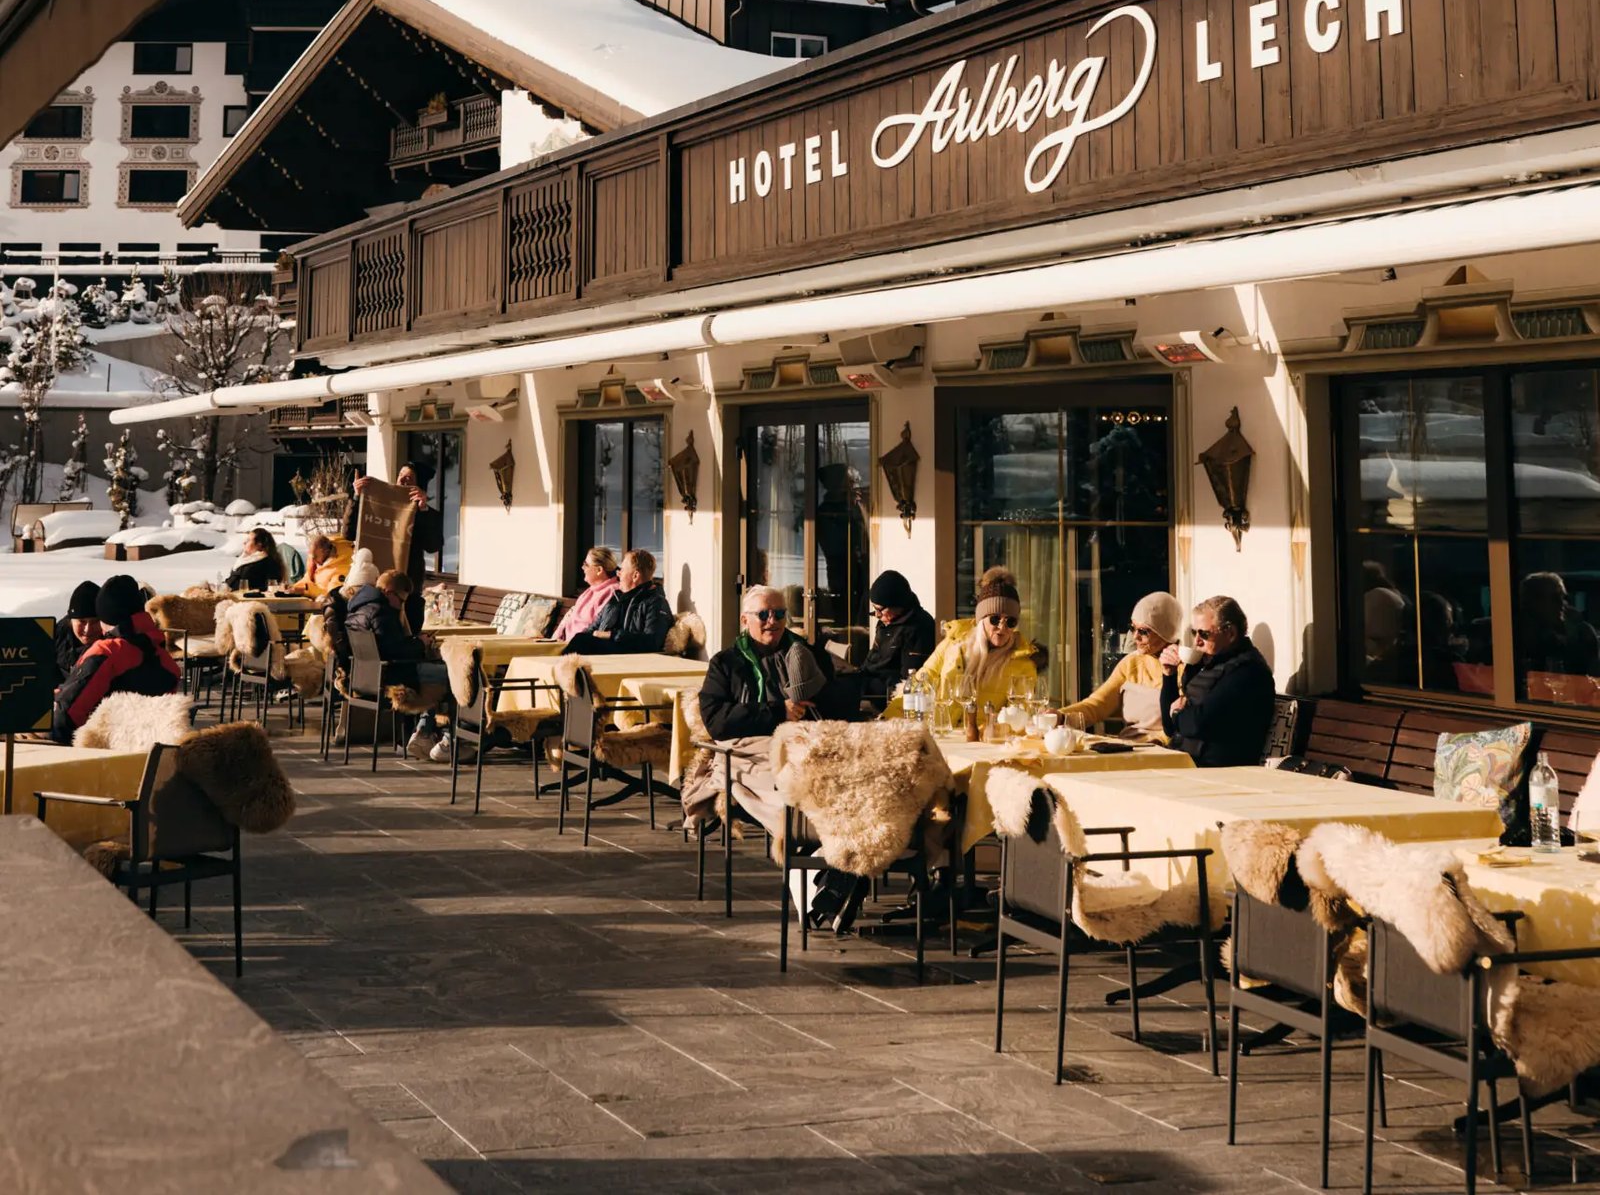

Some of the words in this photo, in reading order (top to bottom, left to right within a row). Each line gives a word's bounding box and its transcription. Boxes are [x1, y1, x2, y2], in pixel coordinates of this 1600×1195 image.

[729, 129, 847, 204] HOTEL
[871, 5, 1156, 193] Arlberg
[1, 647, 29, 659] WC
